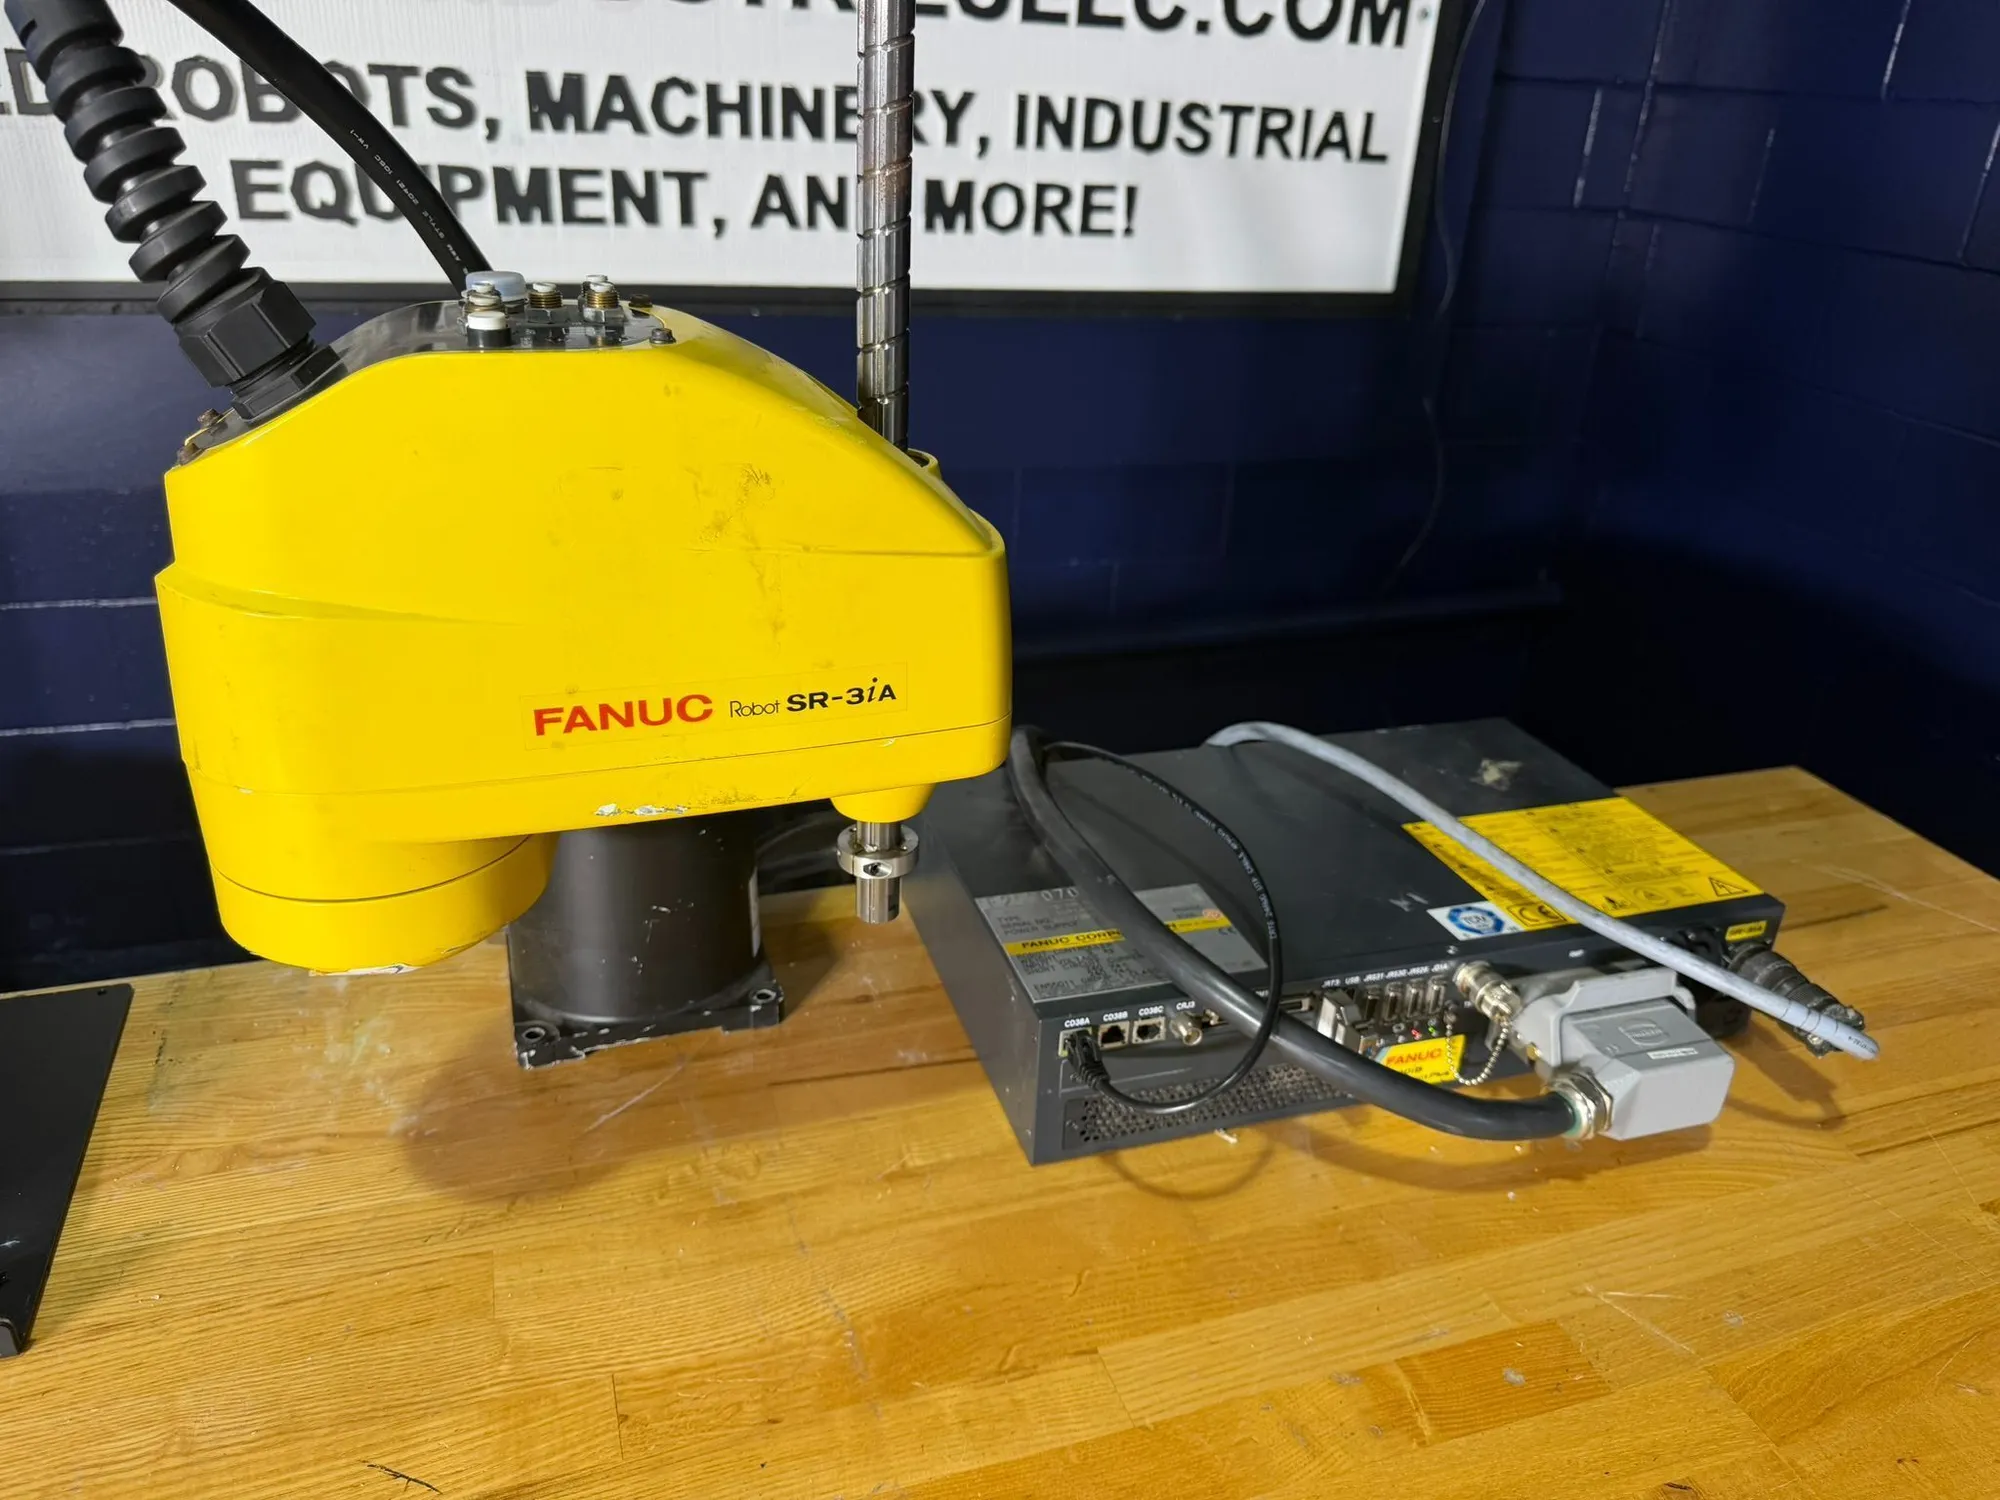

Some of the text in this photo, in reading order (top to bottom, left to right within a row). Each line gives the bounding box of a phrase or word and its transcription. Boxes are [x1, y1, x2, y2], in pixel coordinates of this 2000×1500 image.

[525, 69, 990, 158] MACHINEY,
[1014, 93, 1389, 164] INDUSTRIAL
[350, 129, 370, 150] VW-1
[229, 157, 1139, 239] EQUPMENT, AN MORE!
[421, 210, 445, 240] STYLE
[533, 676, 897, 736] FANUC Robot SR-3iA
[1021, 936, 1070, 949] FANUC
[1064, 1017, 1091, 1029] CD38A
[1102, 1010, 1129, 1022] CD38B
[1138, 1005, 1165, 1017] CD38C
[1344, 975, 1360, 985] USB
[1384, 1047, 1443, 1066] FANUC
